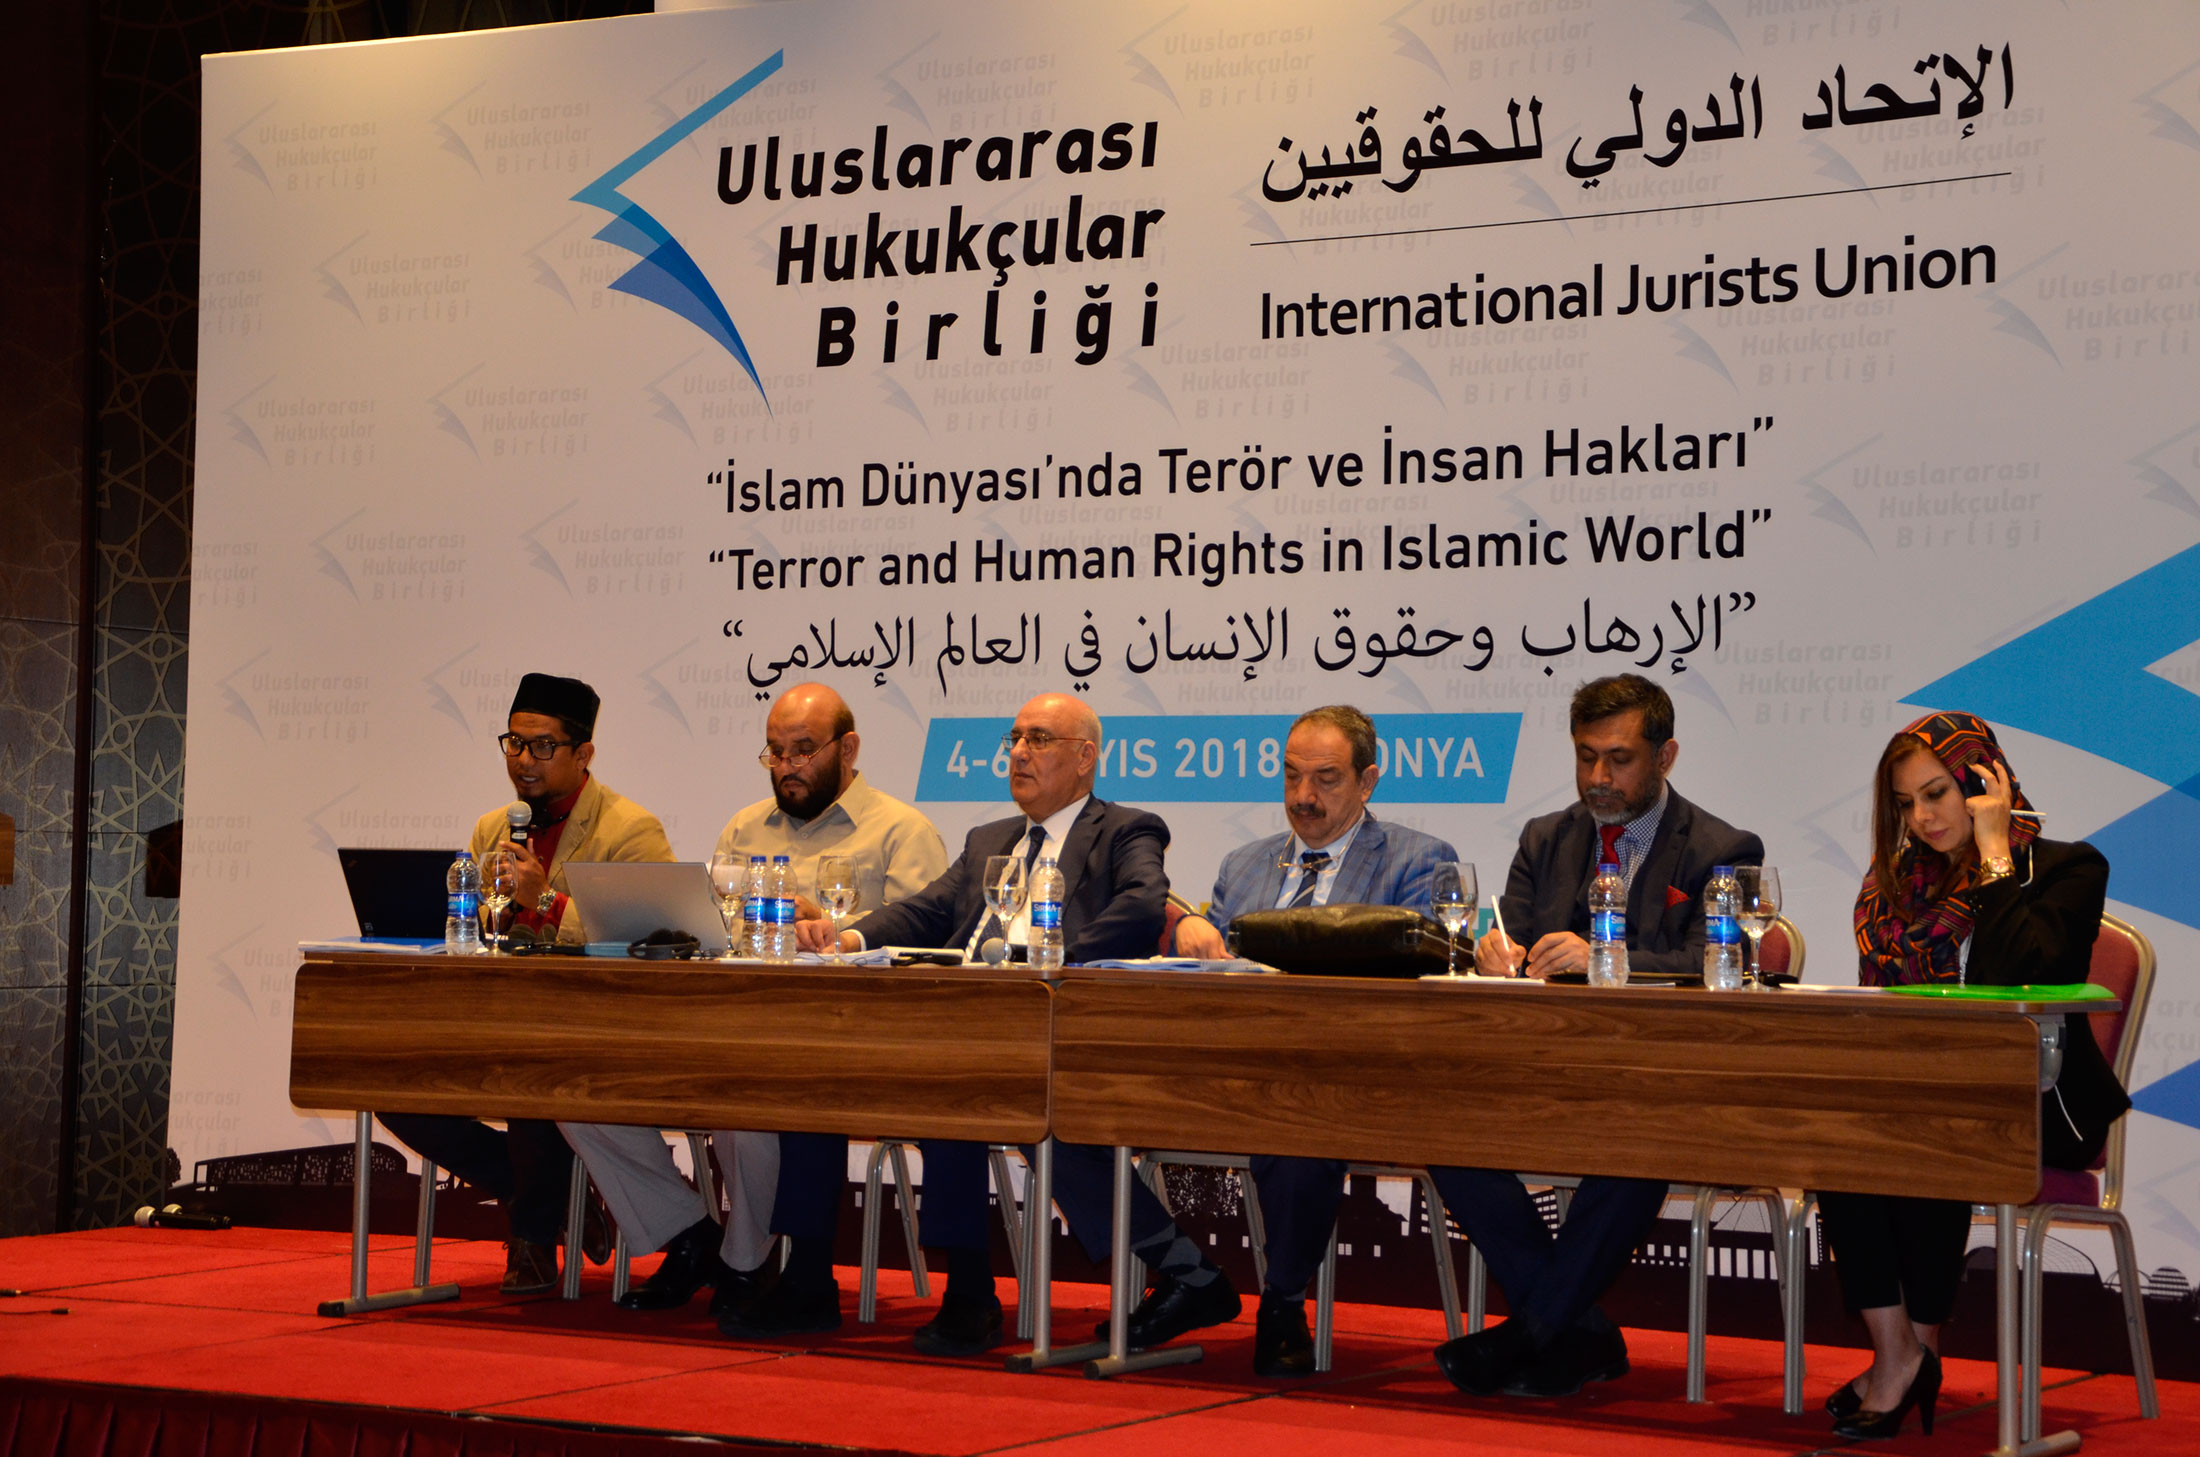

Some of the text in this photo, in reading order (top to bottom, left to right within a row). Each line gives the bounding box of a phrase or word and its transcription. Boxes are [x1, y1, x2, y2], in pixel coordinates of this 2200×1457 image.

[717, 122, 1158, 205] Uluslararası
[1262, 42, 2014, 203] الإتحاد الدولي للحقوقيين
[776, 194, 1166, 288] Hukukçular
[816, 281, 1159, 367] Birliği
[1262, 234, 1996, 340] International Jurists Union
[1158, 444, 1292, 494] Terör
[1307, 452, 1363, 488] ve
[1383, 425, 1523, 485] İnsan
[879, 540, 957, 586] and
[975, 538, 1135, 583] Human
[1154, 530, 1304, 588] Rights
[1323, 527, 1363, 572] in
[1384, 519, 1568, 571] Islamic
[937, 611, 1040, 697] العالم
[1064, 609, 1102, 694] في
[1126, 607, 1288, 682] الإنسان
[1314, 606, 1494, 678] وحقوق
[1099, 738, 1157, 778] YIS
[1175, 737, 1280, 778] 2018
[1376, 737, 1485, 778] ONYA
